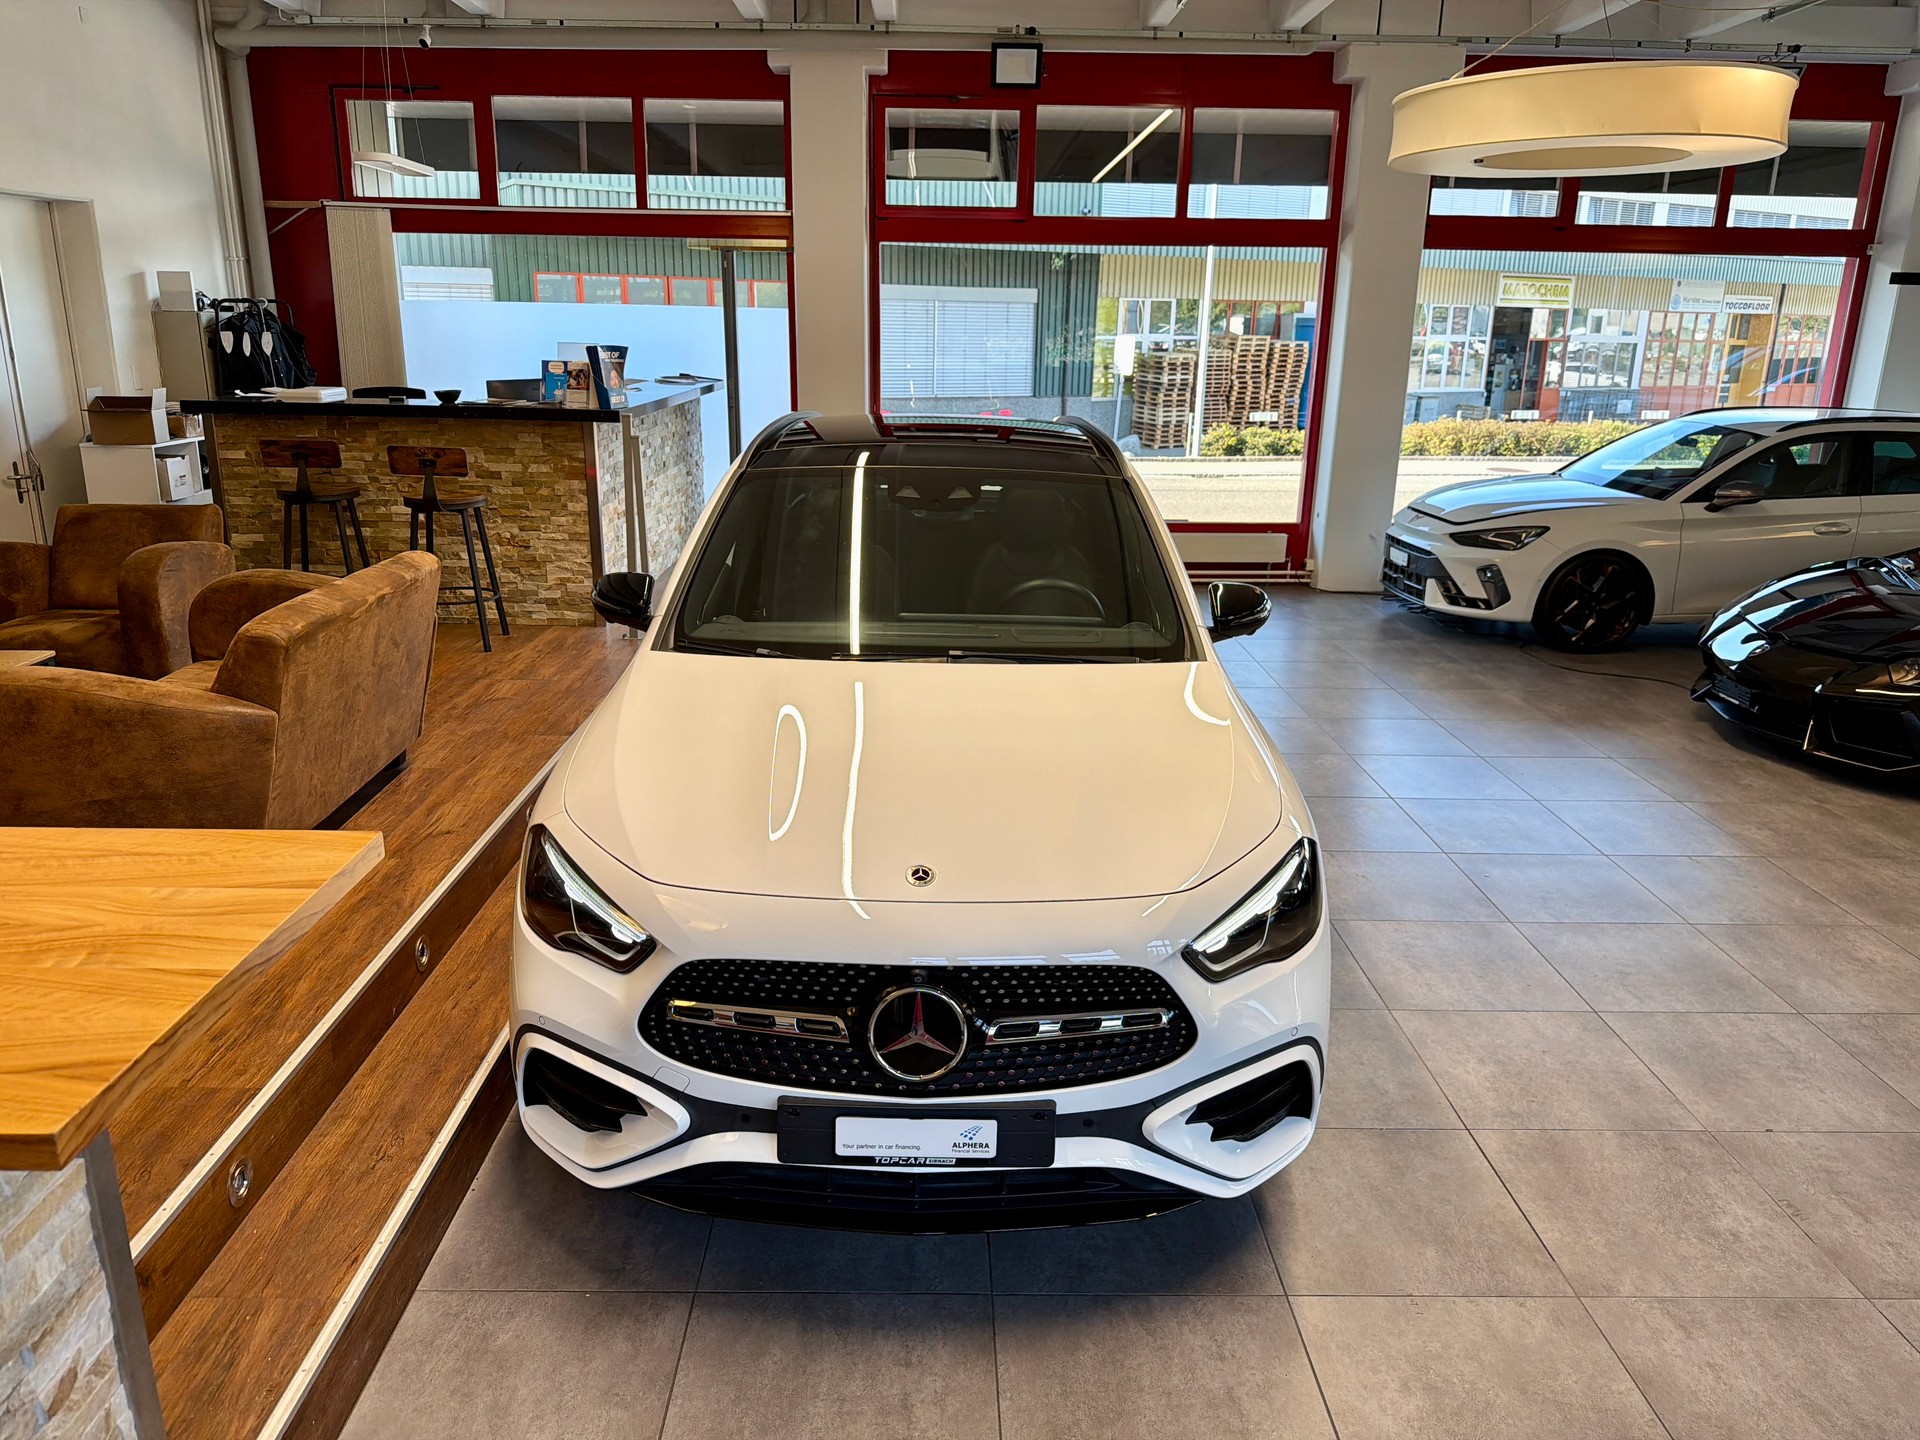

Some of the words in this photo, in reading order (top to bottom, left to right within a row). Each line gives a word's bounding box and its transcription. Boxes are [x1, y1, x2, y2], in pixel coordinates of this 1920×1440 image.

[1502, 282, 1569, 298] MATOCHEM
[1724, 302, 1771, 311] TOCCOFLOOR
[874, 1157, 926, 1165] TOPCAR
